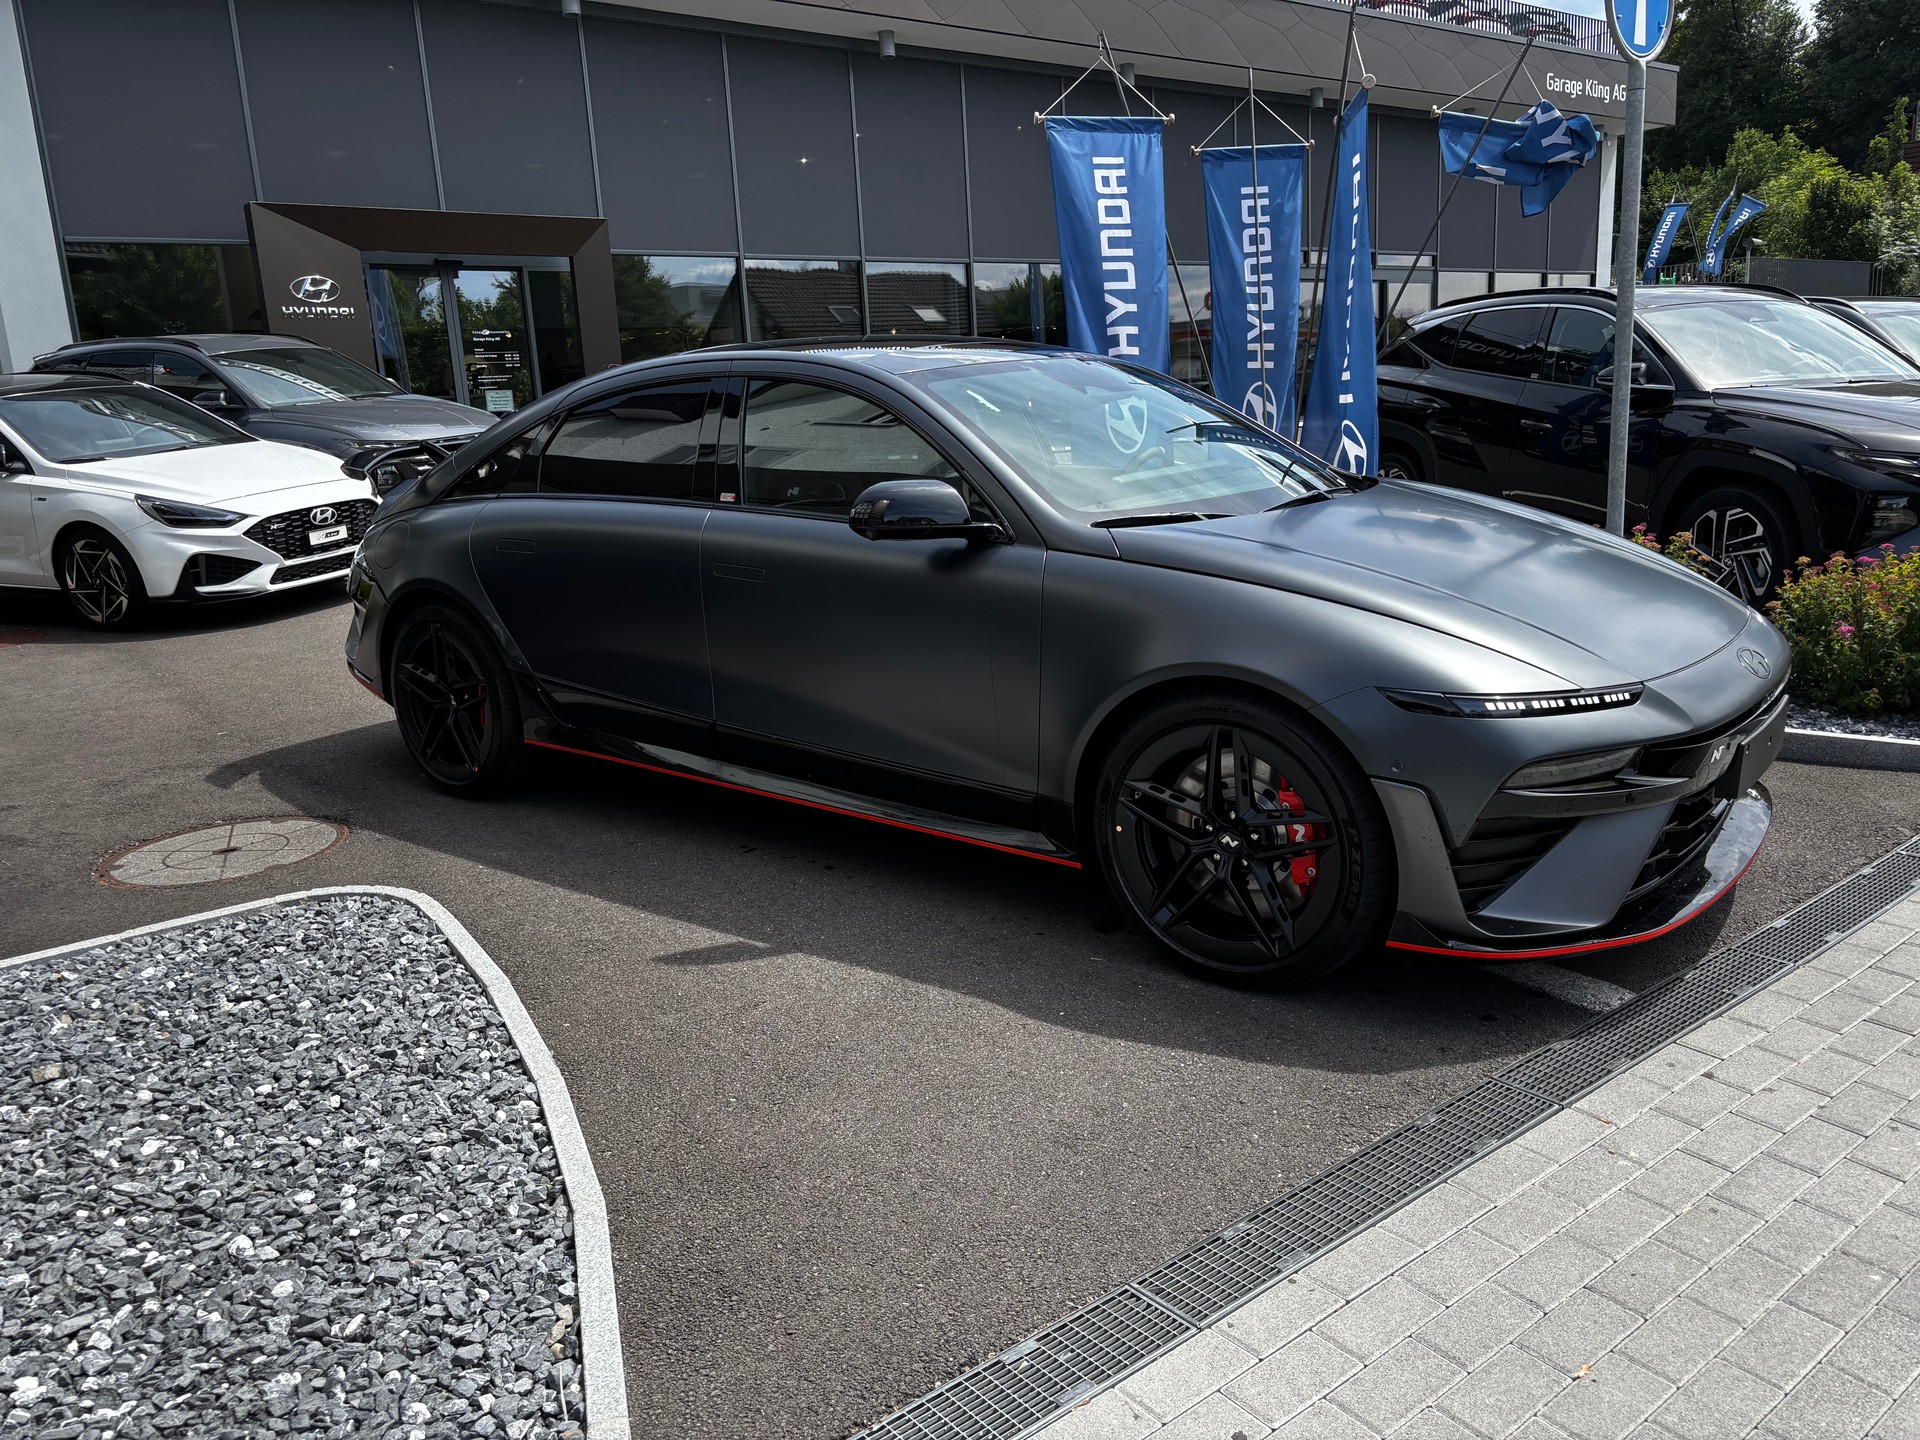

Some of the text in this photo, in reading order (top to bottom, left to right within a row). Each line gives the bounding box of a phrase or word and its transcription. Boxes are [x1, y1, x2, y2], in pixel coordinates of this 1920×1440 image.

[1546, 72, 1627, 104] Garage Küng AG
[1092, 156, 1140, 357] HYUNDAI
[1650, 211, 1677, 258] HYUNDAI
[1240, 185, 1275, 369] HYUNDAI
[281, 306, 355, 319] HYUNDAI
[1347, 847, 1361, 910] ZERO
